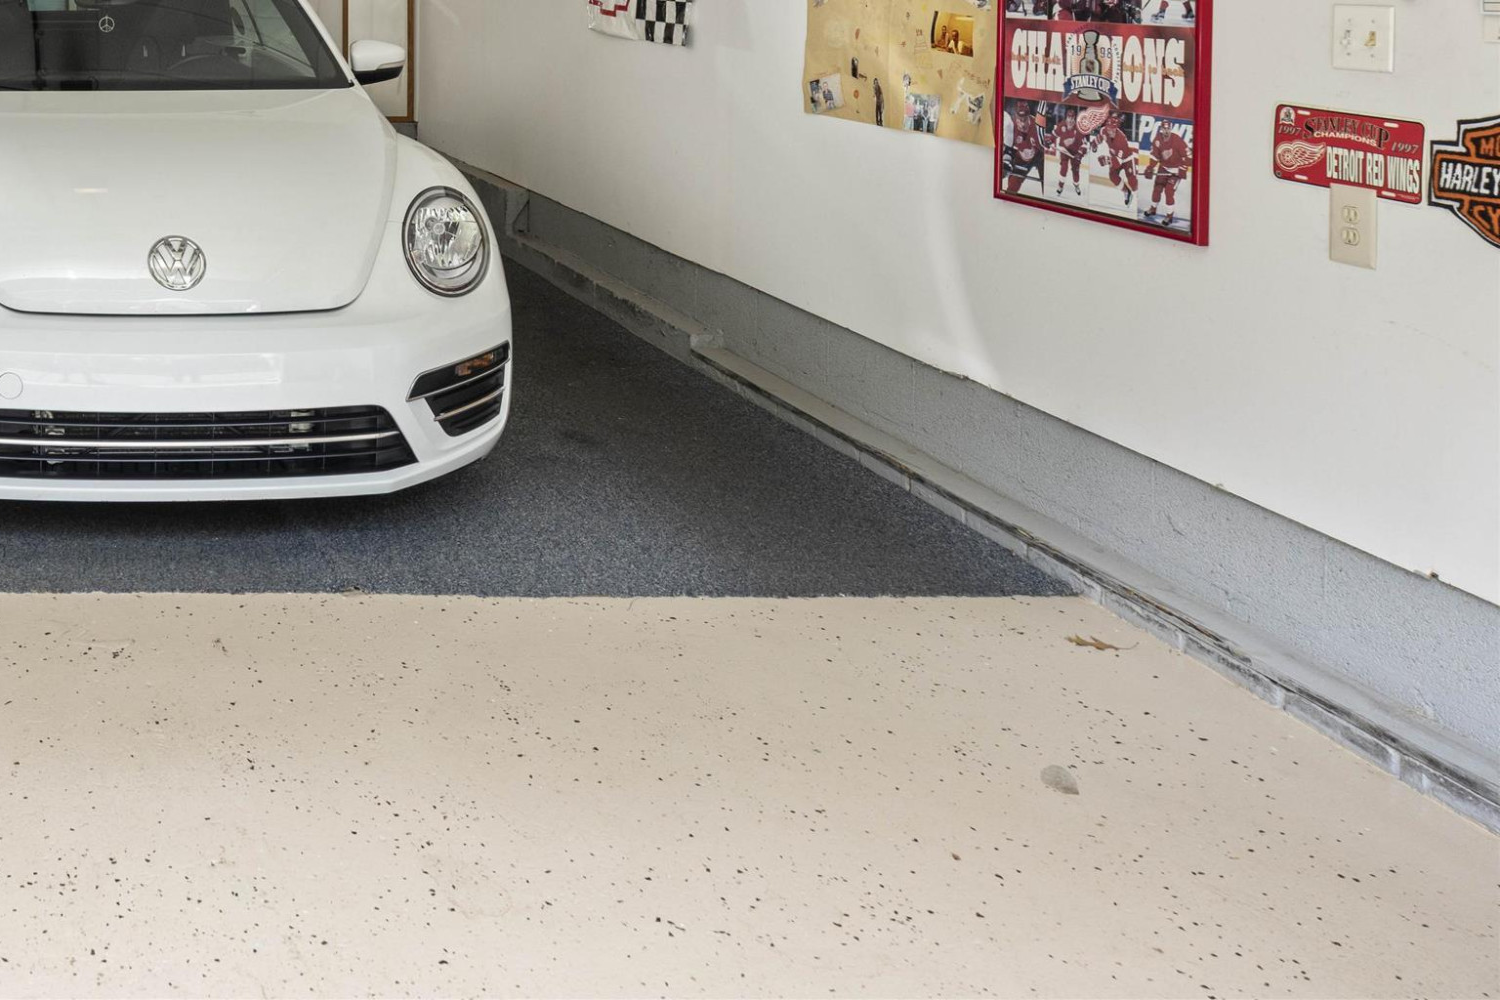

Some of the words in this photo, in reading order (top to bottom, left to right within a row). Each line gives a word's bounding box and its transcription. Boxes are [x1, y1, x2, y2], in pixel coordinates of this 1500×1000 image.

[1070, 75, 1098, 90] STANLEY
[1098, 77, 1111, 93] CUP
[1278, 125, 1302, 136] 1997
[1303, 117, 1360, 139] STANLEY
[1361, 120, 1390, 149] CUP
[1313, 131, 1377, 147] CHAMPIONS
[1391, 141, 1419, 153] 1997
[1326, 146, 1364, 184] DETROIT
[1366, 152, 1385, 188] RED
[1387, 155, 1420, 194] WINGS
[1440, 161, 1500, 196] HARLEY
